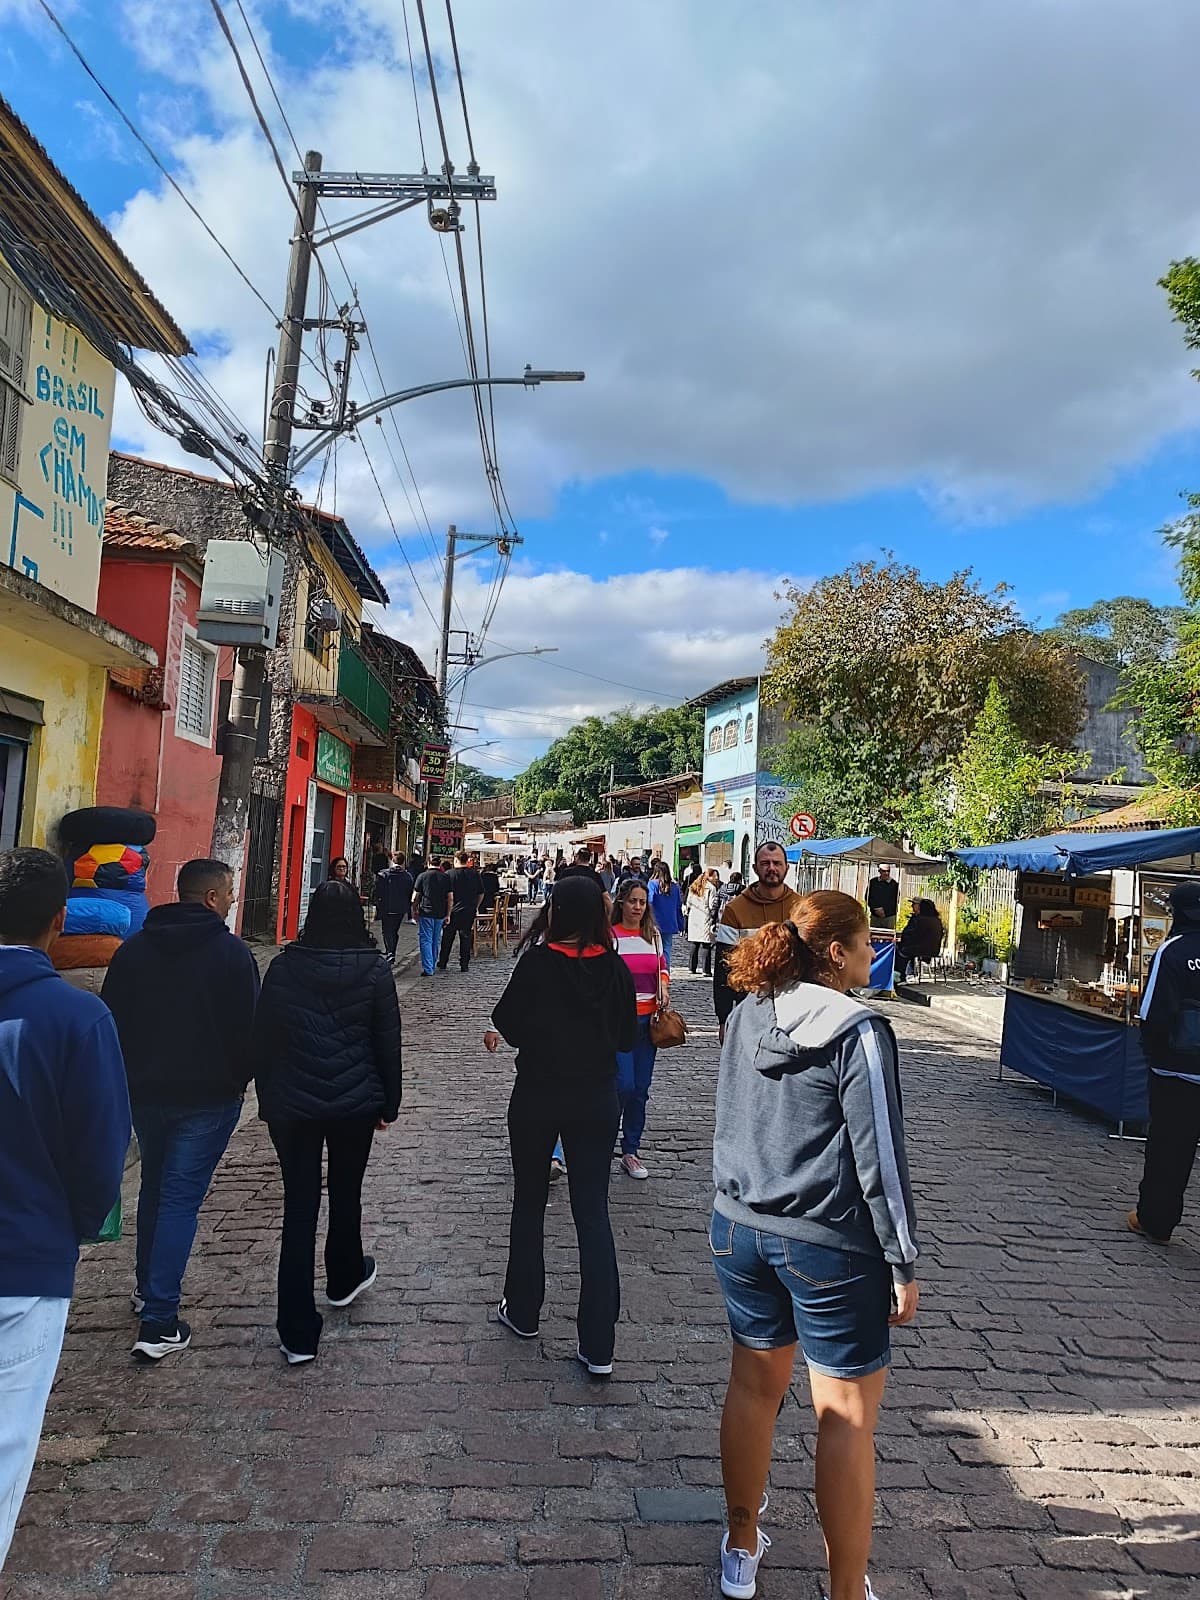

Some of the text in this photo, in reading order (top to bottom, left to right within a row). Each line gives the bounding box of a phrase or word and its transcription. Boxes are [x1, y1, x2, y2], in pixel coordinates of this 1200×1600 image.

[36, 365, 104, 419] BRASIL
[428, 757, 441, 766] 3D
[439, 837, 454, 846] 3D
